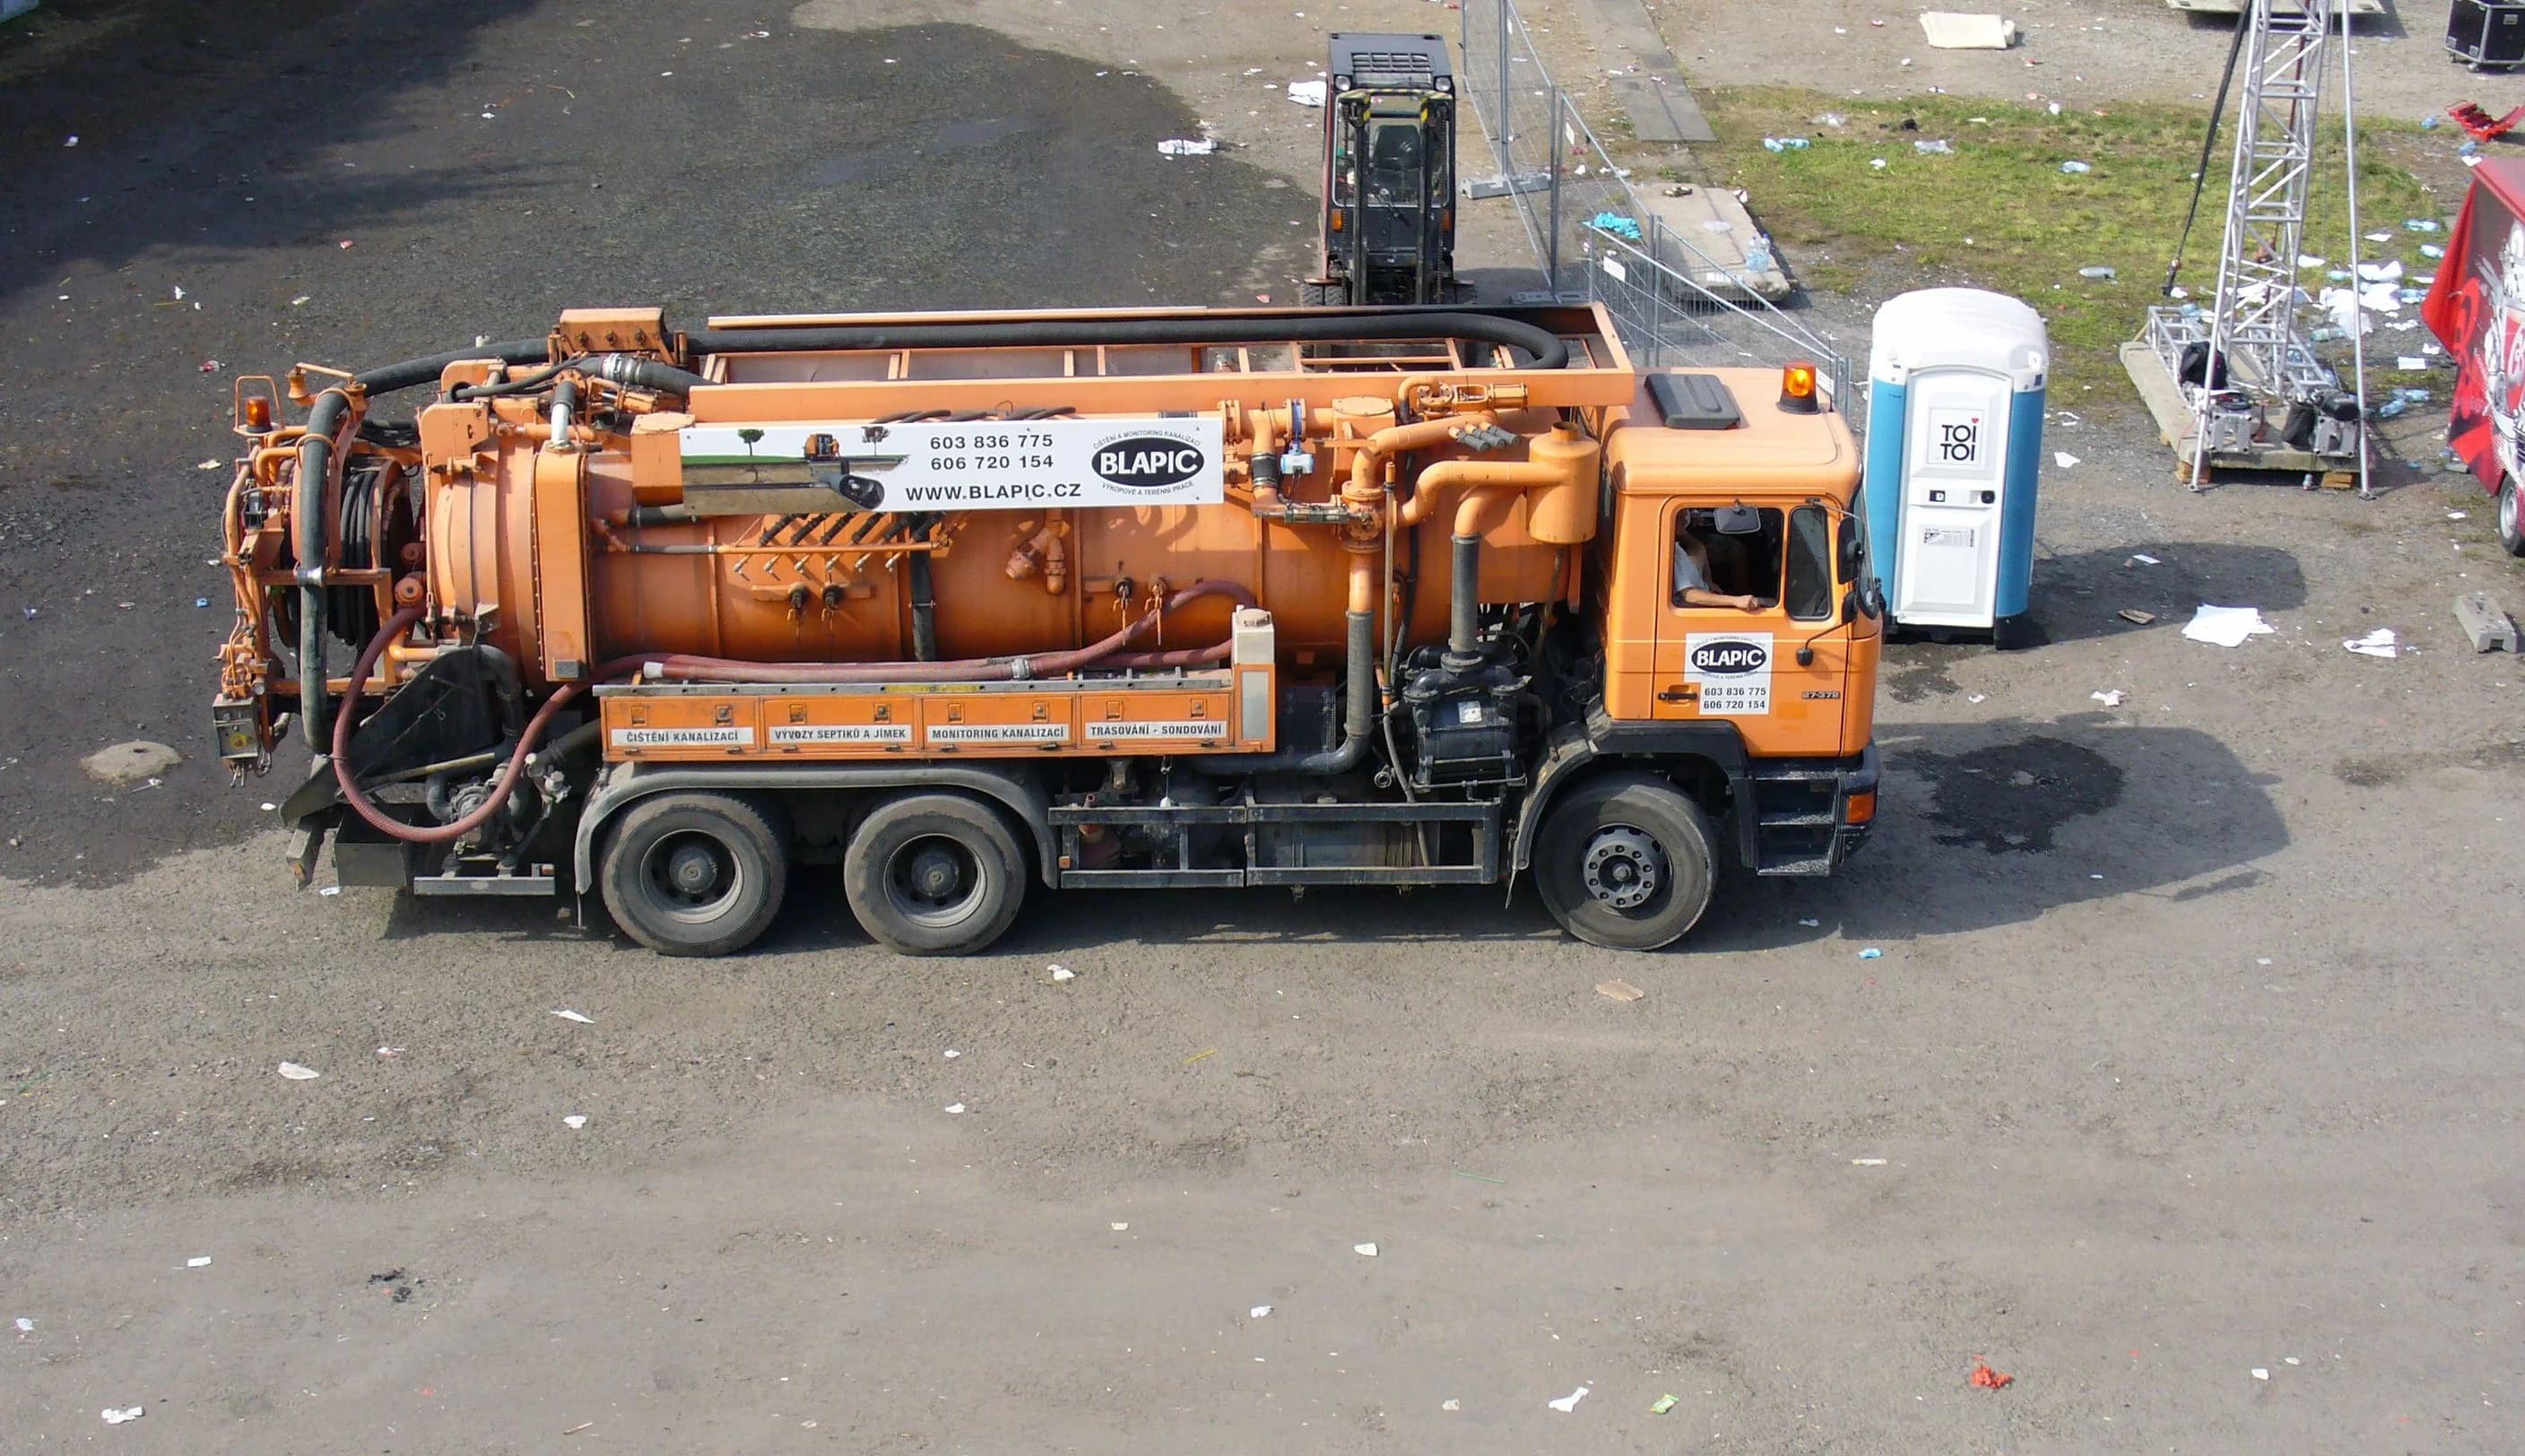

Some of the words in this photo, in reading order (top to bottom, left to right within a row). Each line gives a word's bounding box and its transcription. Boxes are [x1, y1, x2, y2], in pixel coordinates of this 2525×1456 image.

[1124, 429, 1163, 438] MONITORING
[1941, 424, 1976, 443] TOI
[931, 437, 965, 449] 603
[974, 436, 1010, 448] 836
[1018, 434, 1053, 447] 775
[1939, 444, 1975, 461] TOI
[932, 457, 967, 471] 606
[975, 456, 1011, 469] 720
[1020, 455, 1054, 468] 154
[1100, 450, 1198, 474] BLAPIC
[906, 483, 1081, 501] WWW.BLAPIC.CZ
[1696, 650, 1764, 666] BLAPIC
[1705, 688, 1722, 697] 603
[1726, 688, 1745, 696] 836
[1748, 688, 1766, 696] 775
[1704, 700, 1722, 709] 606
[1726, 701, 1743, 709] 720
[1748, 701, 1766, 709] 154
[775, 730, 813, 740] VÝVOZY
[818, 728, 860, 739] SEPTIKŮ
[863, 729, 870, 738] A
[874, 729, 906, 739] JÍMEK
[932, 729, 998, 739] MONITORING
[1002, 727, 1063, 739] KANALIZACÍ
[1090, 724, 1150, 735] TRASOVÁNÍ
[1162, 723, 1221, 734] SONDOVÁNÍ
[627, 732, 669, 742] ČIŠTĚNÍ
[673, 732, 738, 742] KANALIZACÍ
